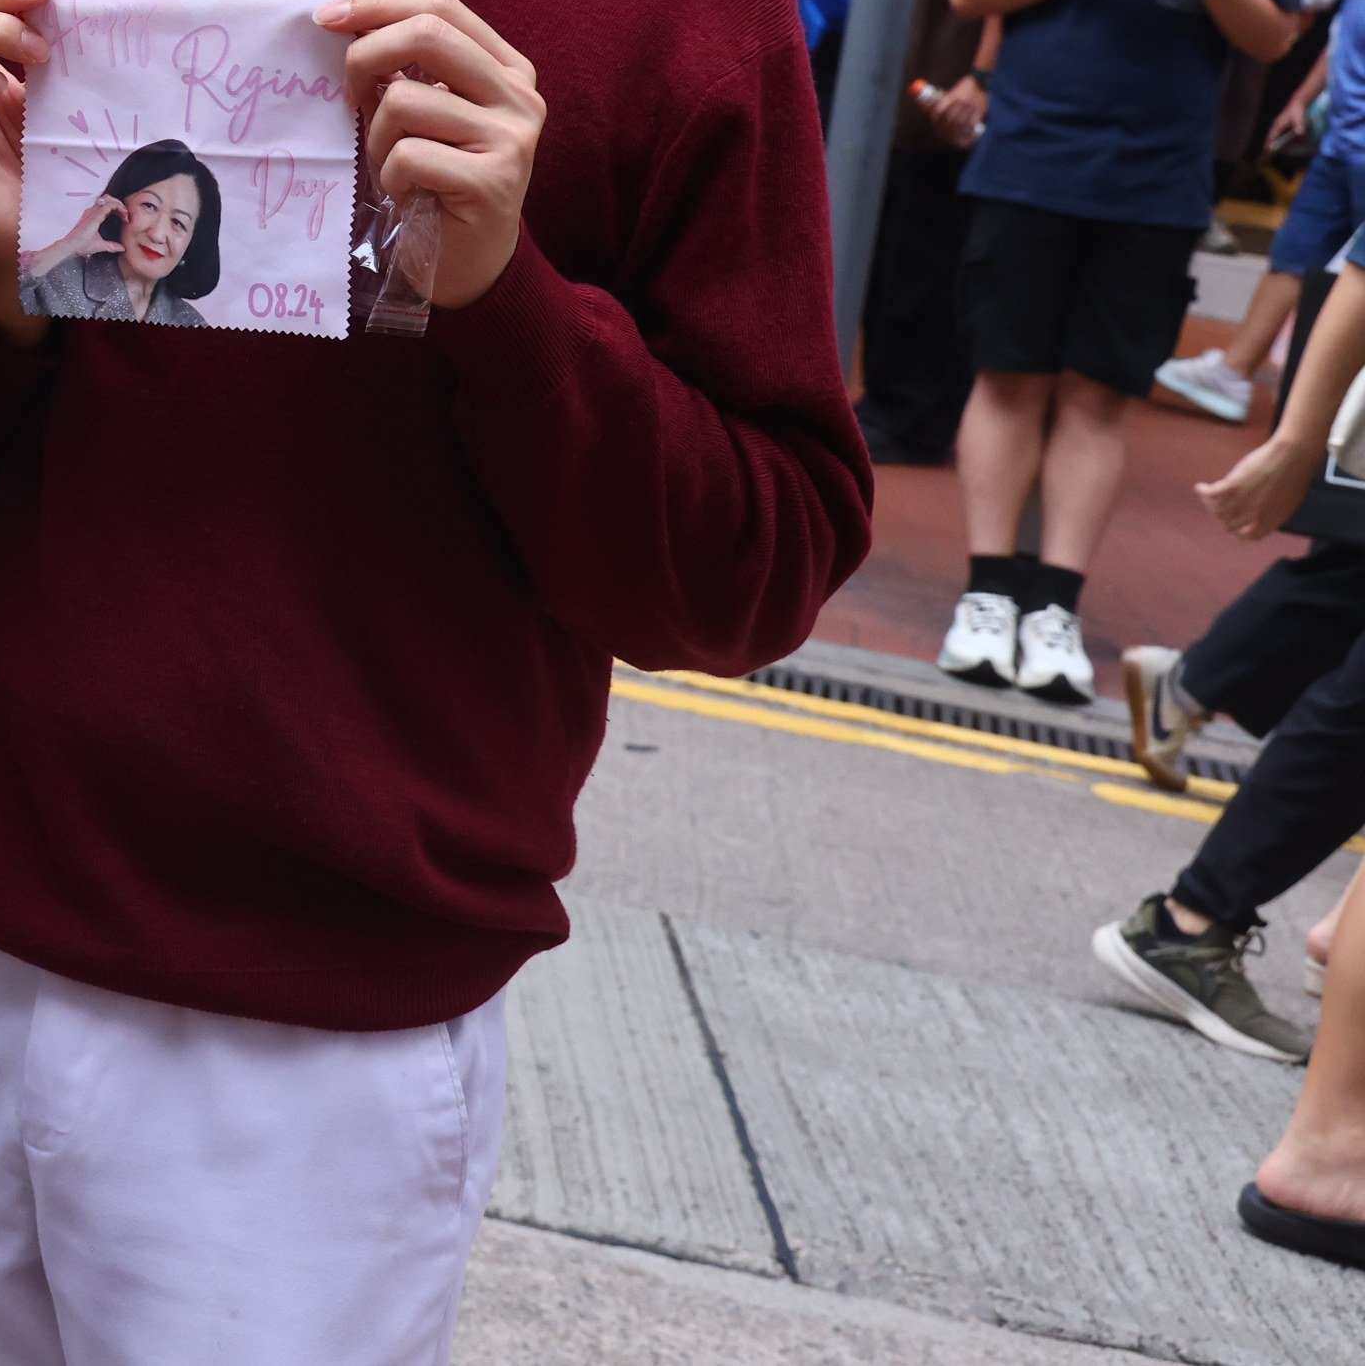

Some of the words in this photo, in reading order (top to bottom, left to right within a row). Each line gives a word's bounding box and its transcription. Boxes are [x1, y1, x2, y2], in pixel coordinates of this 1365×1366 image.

[171, 23, 346, 146] Regina
[250, 147, 339, 242] Day
[247, 281, 326, 325] 08.24
